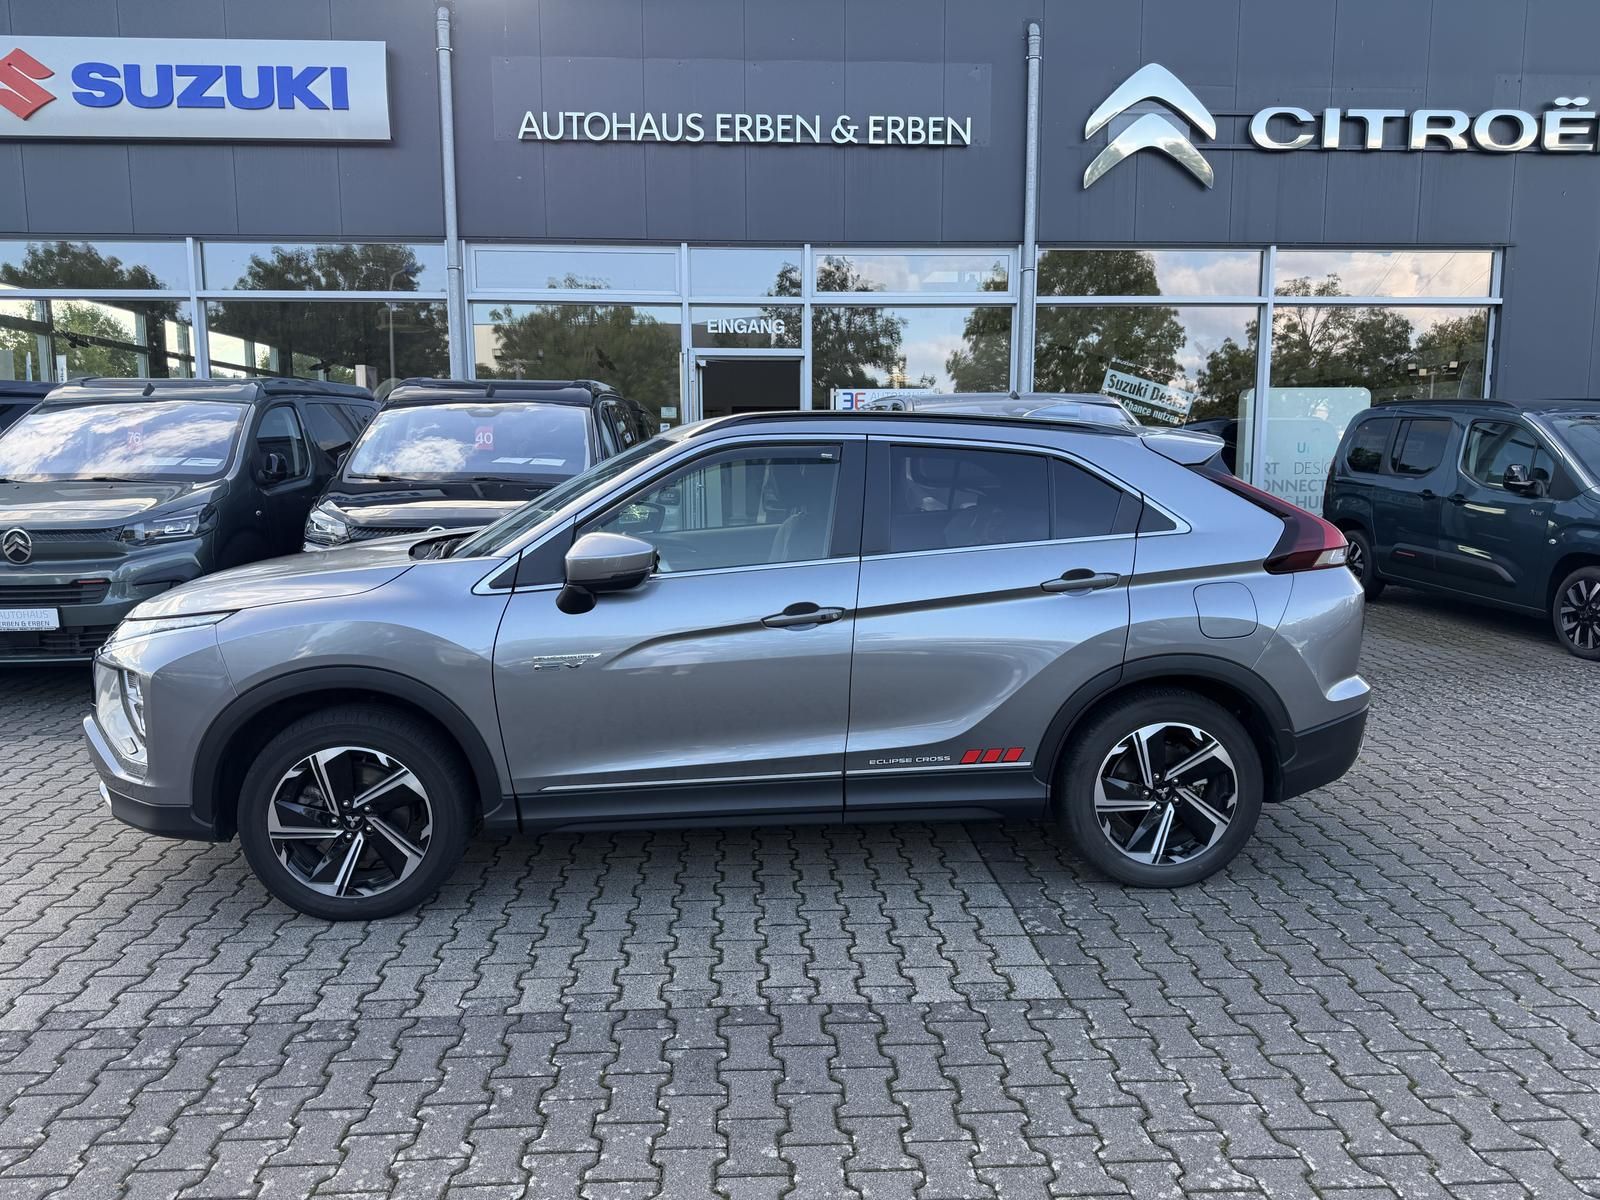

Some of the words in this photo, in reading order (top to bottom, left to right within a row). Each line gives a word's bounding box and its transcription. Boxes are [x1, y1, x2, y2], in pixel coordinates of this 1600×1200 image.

[71, 62, 349, 110] SUZUKI
[518, 110, 705, 142] AUTOHAUS
[715, 113, 821, 143] ERBEN
[831, 115, 859, 144] &
[868, 115, 972, 146] ERBEN
[707, 319, 785, 334] EINGANG
[1107, 374, 1150, 399] Suzuki
[1123, 399, 1153, 416] Chance
[475, 432, 493, 444] 40
[868, 757, 913, 766] ECLIPSE
[915, 755, 951, 763] CROSS
